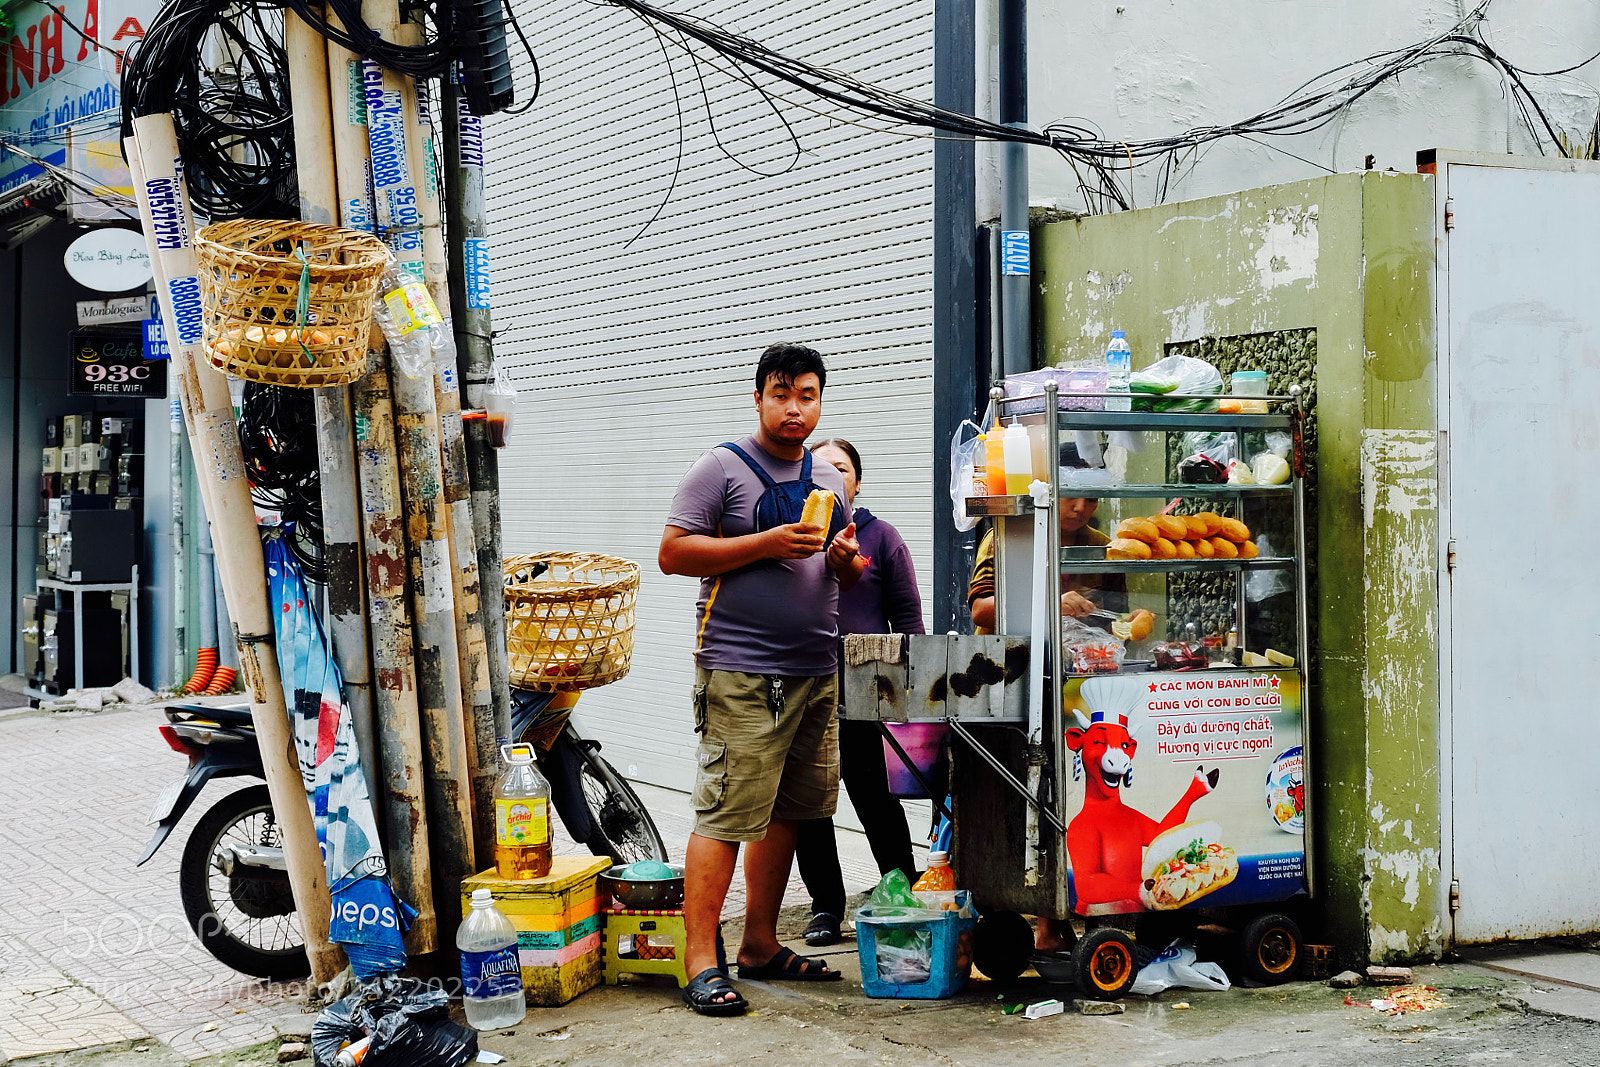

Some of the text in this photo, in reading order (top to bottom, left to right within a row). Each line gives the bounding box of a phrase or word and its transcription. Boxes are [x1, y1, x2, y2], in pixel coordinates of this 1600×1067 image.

[82, 304, 143, 318] Monologues
[93, 383, 143, 392] FREE WIFI
[1160, 678, 1182, 691] CÁC
[1186, 677, 1214, 690] MÓN
[1217, 675, 1249, 689] BÁNH
[1148, 698, 1180, 711] CÙNG
[1184, 696, 1203, 709] VỚI
[1207, 697, 1231, 707] CON
[1235, 694, 1251, 706] BÒ
[1157, 720, 1181, 739] Đầy
[1183, 720, 1197, 734] đủ
[1201, 720, 1240, 735] dưỡng
[1158, 735, 1273, 756] Hương vị cực ngon!
[481, 956, 520, 981] AQUAFINA
